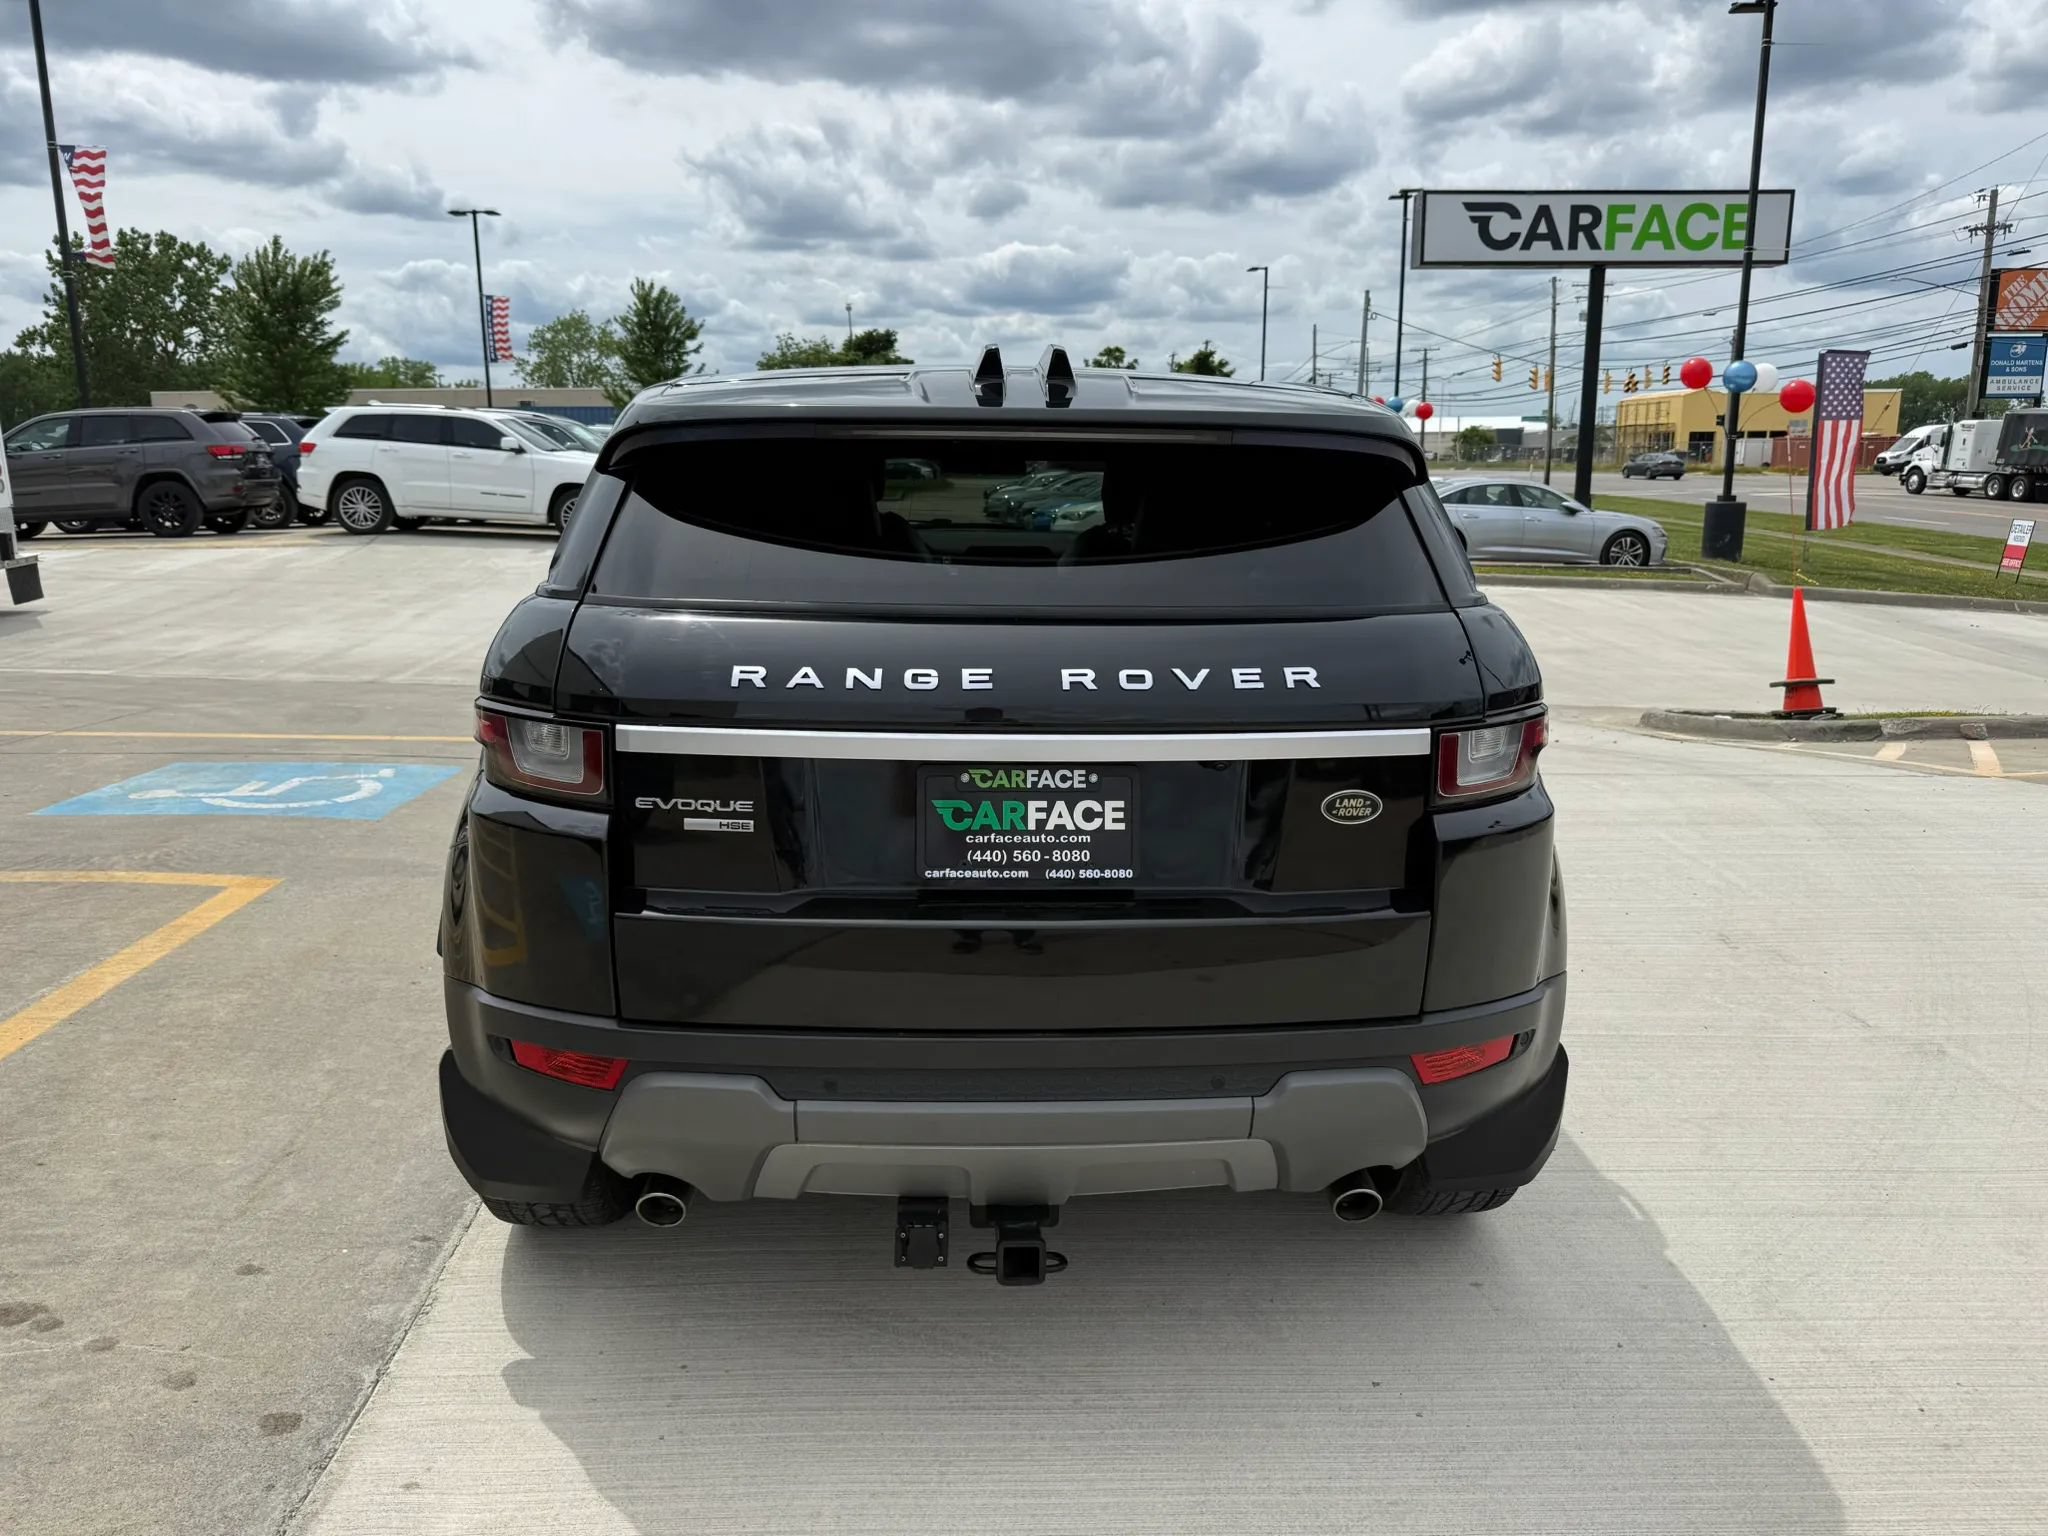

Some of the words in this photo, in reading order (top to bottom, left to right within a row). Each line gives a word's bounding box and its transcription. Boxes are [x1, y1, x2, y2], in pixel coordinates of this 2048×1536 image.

[1462, 202, 1749, 251] CARFACE
[2001, 274, 2028, 300] THE
[730, 665, 994, 690] RANGE
[1061, 666, 1321, 690] ROVER
[968, 769, 1087, 788] CARFACE
[635, 797, 754, 812] EVOQUE
[1335, 798, 1364, 807] LAND
[931, 800, 1126, 831] CARFACE
[1337, 807, 1372, 817] ROVER
[719, 821, 752, 830] HSE
[965, 833, 1091, 844] carfaceauto.com
[967, 850, 1007, 865] (440)
[924, 868, 1030, 879] carfaceauto.com
[1045, 868, 1076, 880] (440)
[1078, 869, 1133, 879] 560-8080
